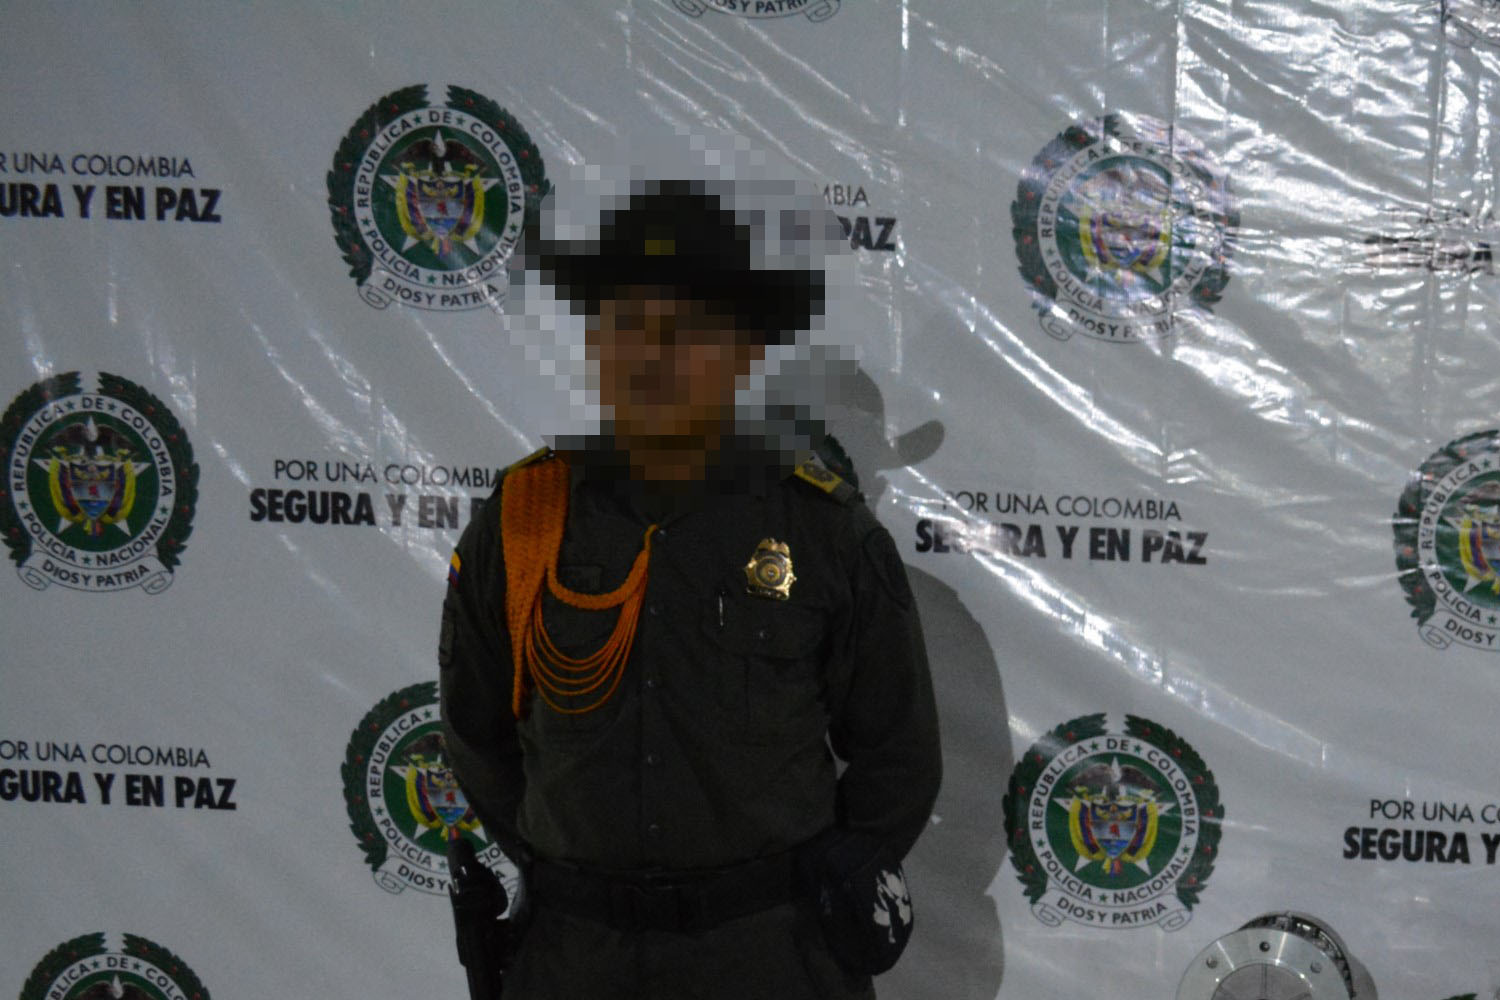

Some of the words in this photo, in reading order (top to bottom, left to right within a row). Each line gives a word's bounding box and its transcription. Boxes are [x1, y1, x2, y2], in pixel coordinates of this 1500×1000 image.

[13, 153, 66, 173] UNA
[71, 155, 194, 177] COLOMBIA
[430, 111, 452, 123] DE
[472, 123, 522, 213] COLOMBIA
[73, 185, 94, 218] Y
[104, 186, 145, 220] EN
[157, 187, 220, 222] PAZ
[81, 396, 103, 409] DE
[122, 409, 172, 496] COLOMBIA
[274, 459, 318, 481] POR
[326, 462, 379, 482] UNA
[248, 489, 377, 526] SEGURA
[386, 494, 407, 527] Y
[418, 495, 458, 528] EN
[996, 494, 1049, 514] UNA
[1056, 497, 1182, 520] COLOMBIA
[96, 518, 167, 565] NACIONAL
[1056, 526, 1078, 559] Y
[1089, 527, 1130, 561] EN
[1142, 529, 1208, 564] PAZ
[97, 564, 149, 586] PATRIA
[0, 740, 29, 760] OR
[36, 742, 87, 762] UNA
[92, 745, 211, 767] COLOMBIA
[94, 773, 114, 804] Y
[124, 774, 164, 806] EN
[175, 776, 236, 810] PAZ
[1107, 738, 1129, 750] DE
[1148, 750, 1196, 836] COLOMBIA
[1370, 799, 1414, 820] POR
[1423, 803, 1475, 822] UNA
[1343, 827, 1470, 863] SEGURA
[1114, 857, 1188, 903] NACIONAL
[1113, 902, 1167, 923] PATRIA
[107, 956, 128, 968] DE
